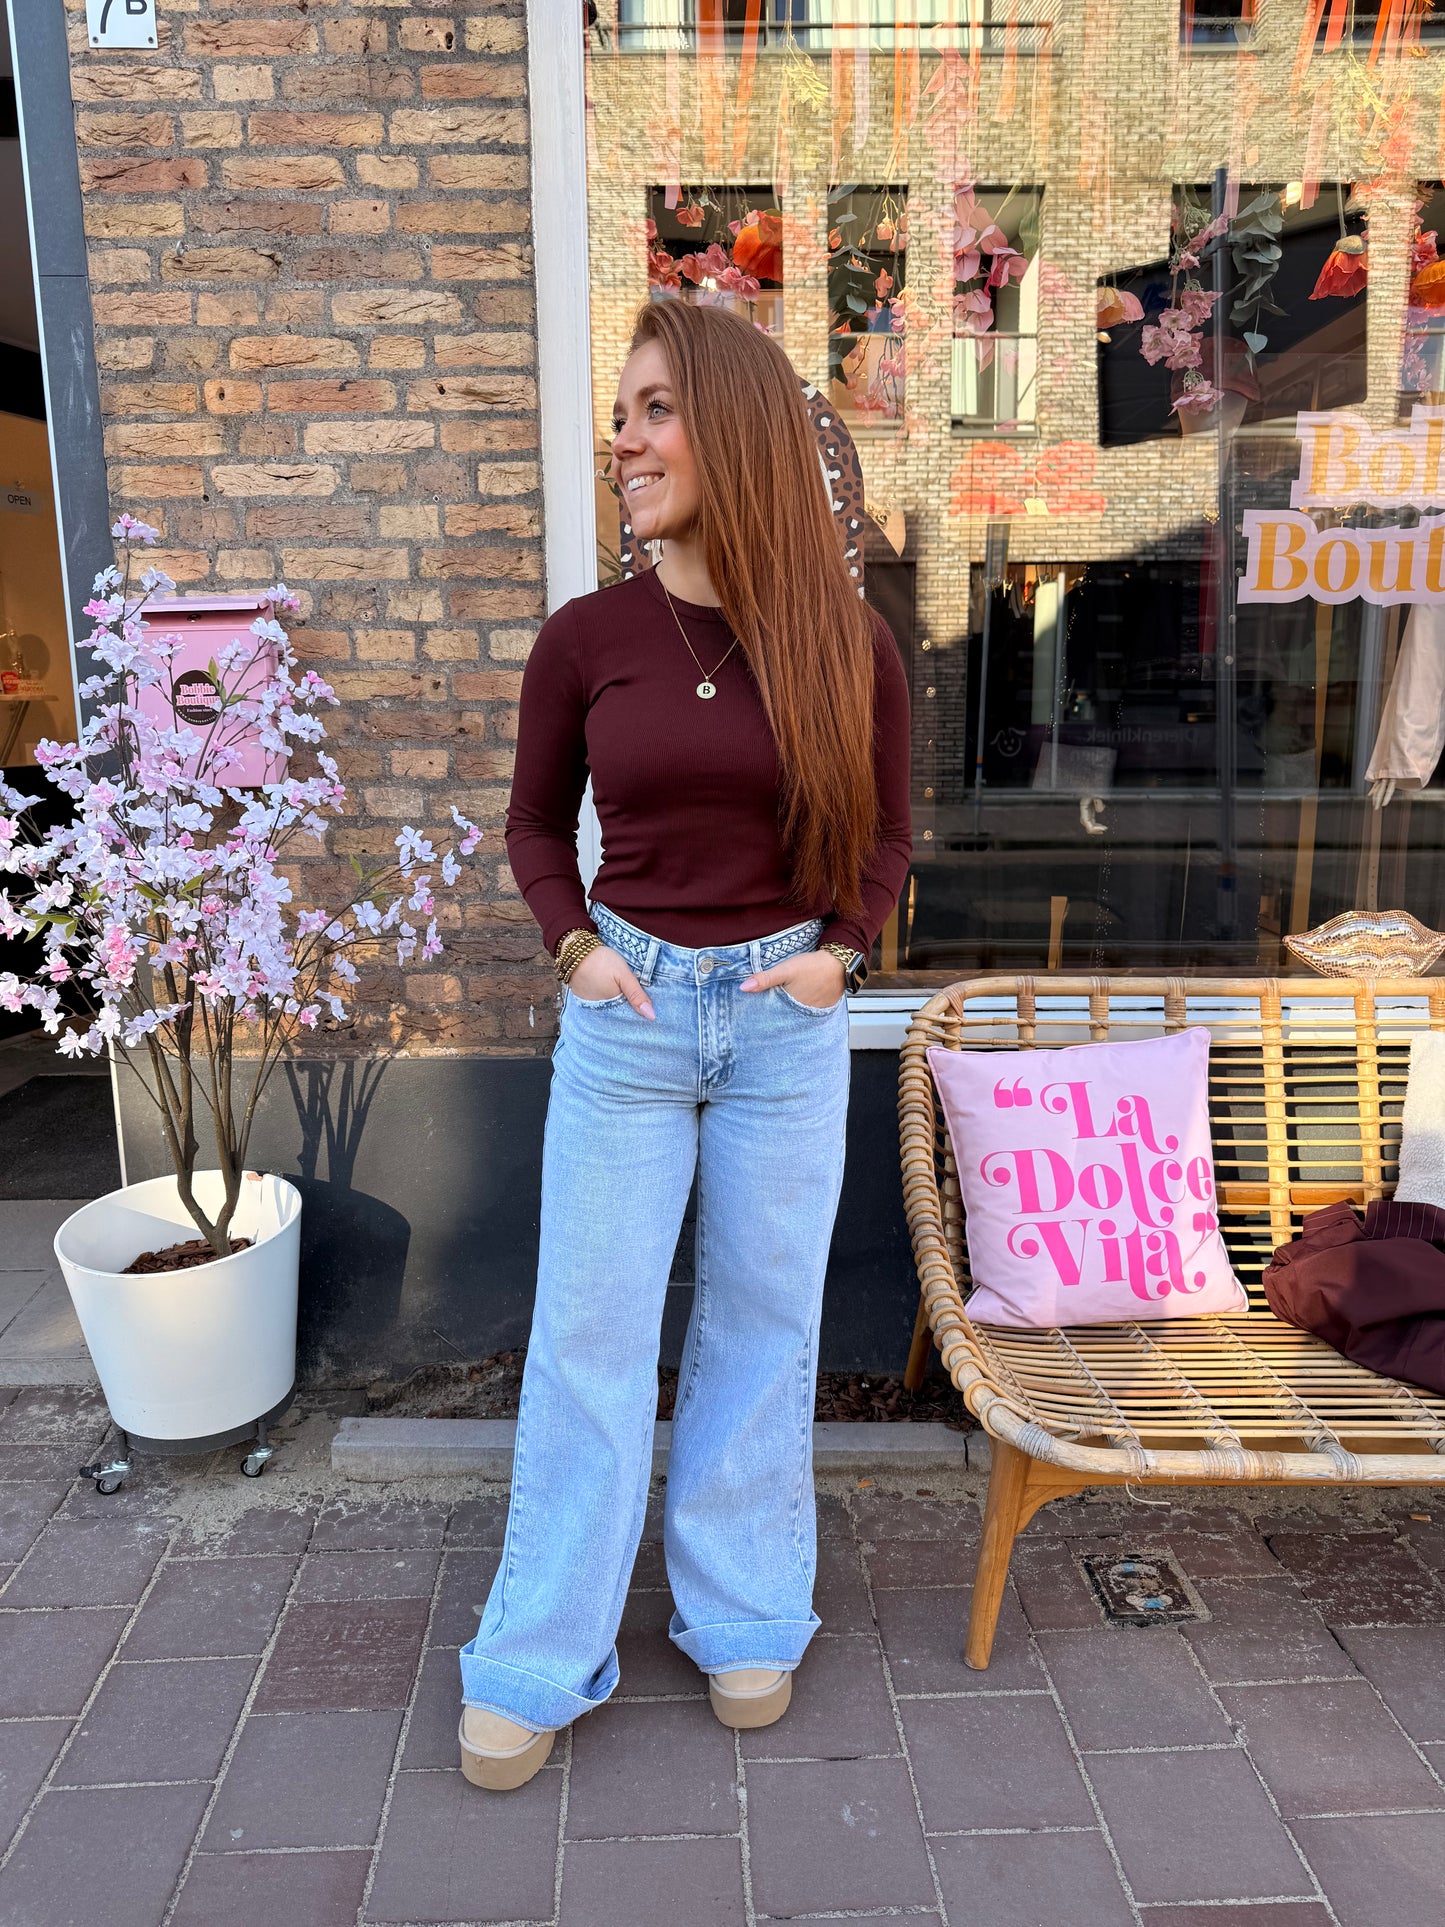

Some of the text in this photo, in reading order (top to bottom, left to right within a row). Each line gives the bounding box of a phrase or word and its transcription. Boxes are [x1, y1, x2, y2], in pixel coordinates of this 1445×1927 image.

[8, 494, 31, 506] OPEN
[181, 683, 215, 694] Bobbie
[703, 686, 710, 694] B
[980, 1143, 1211, 1228] Dolce
